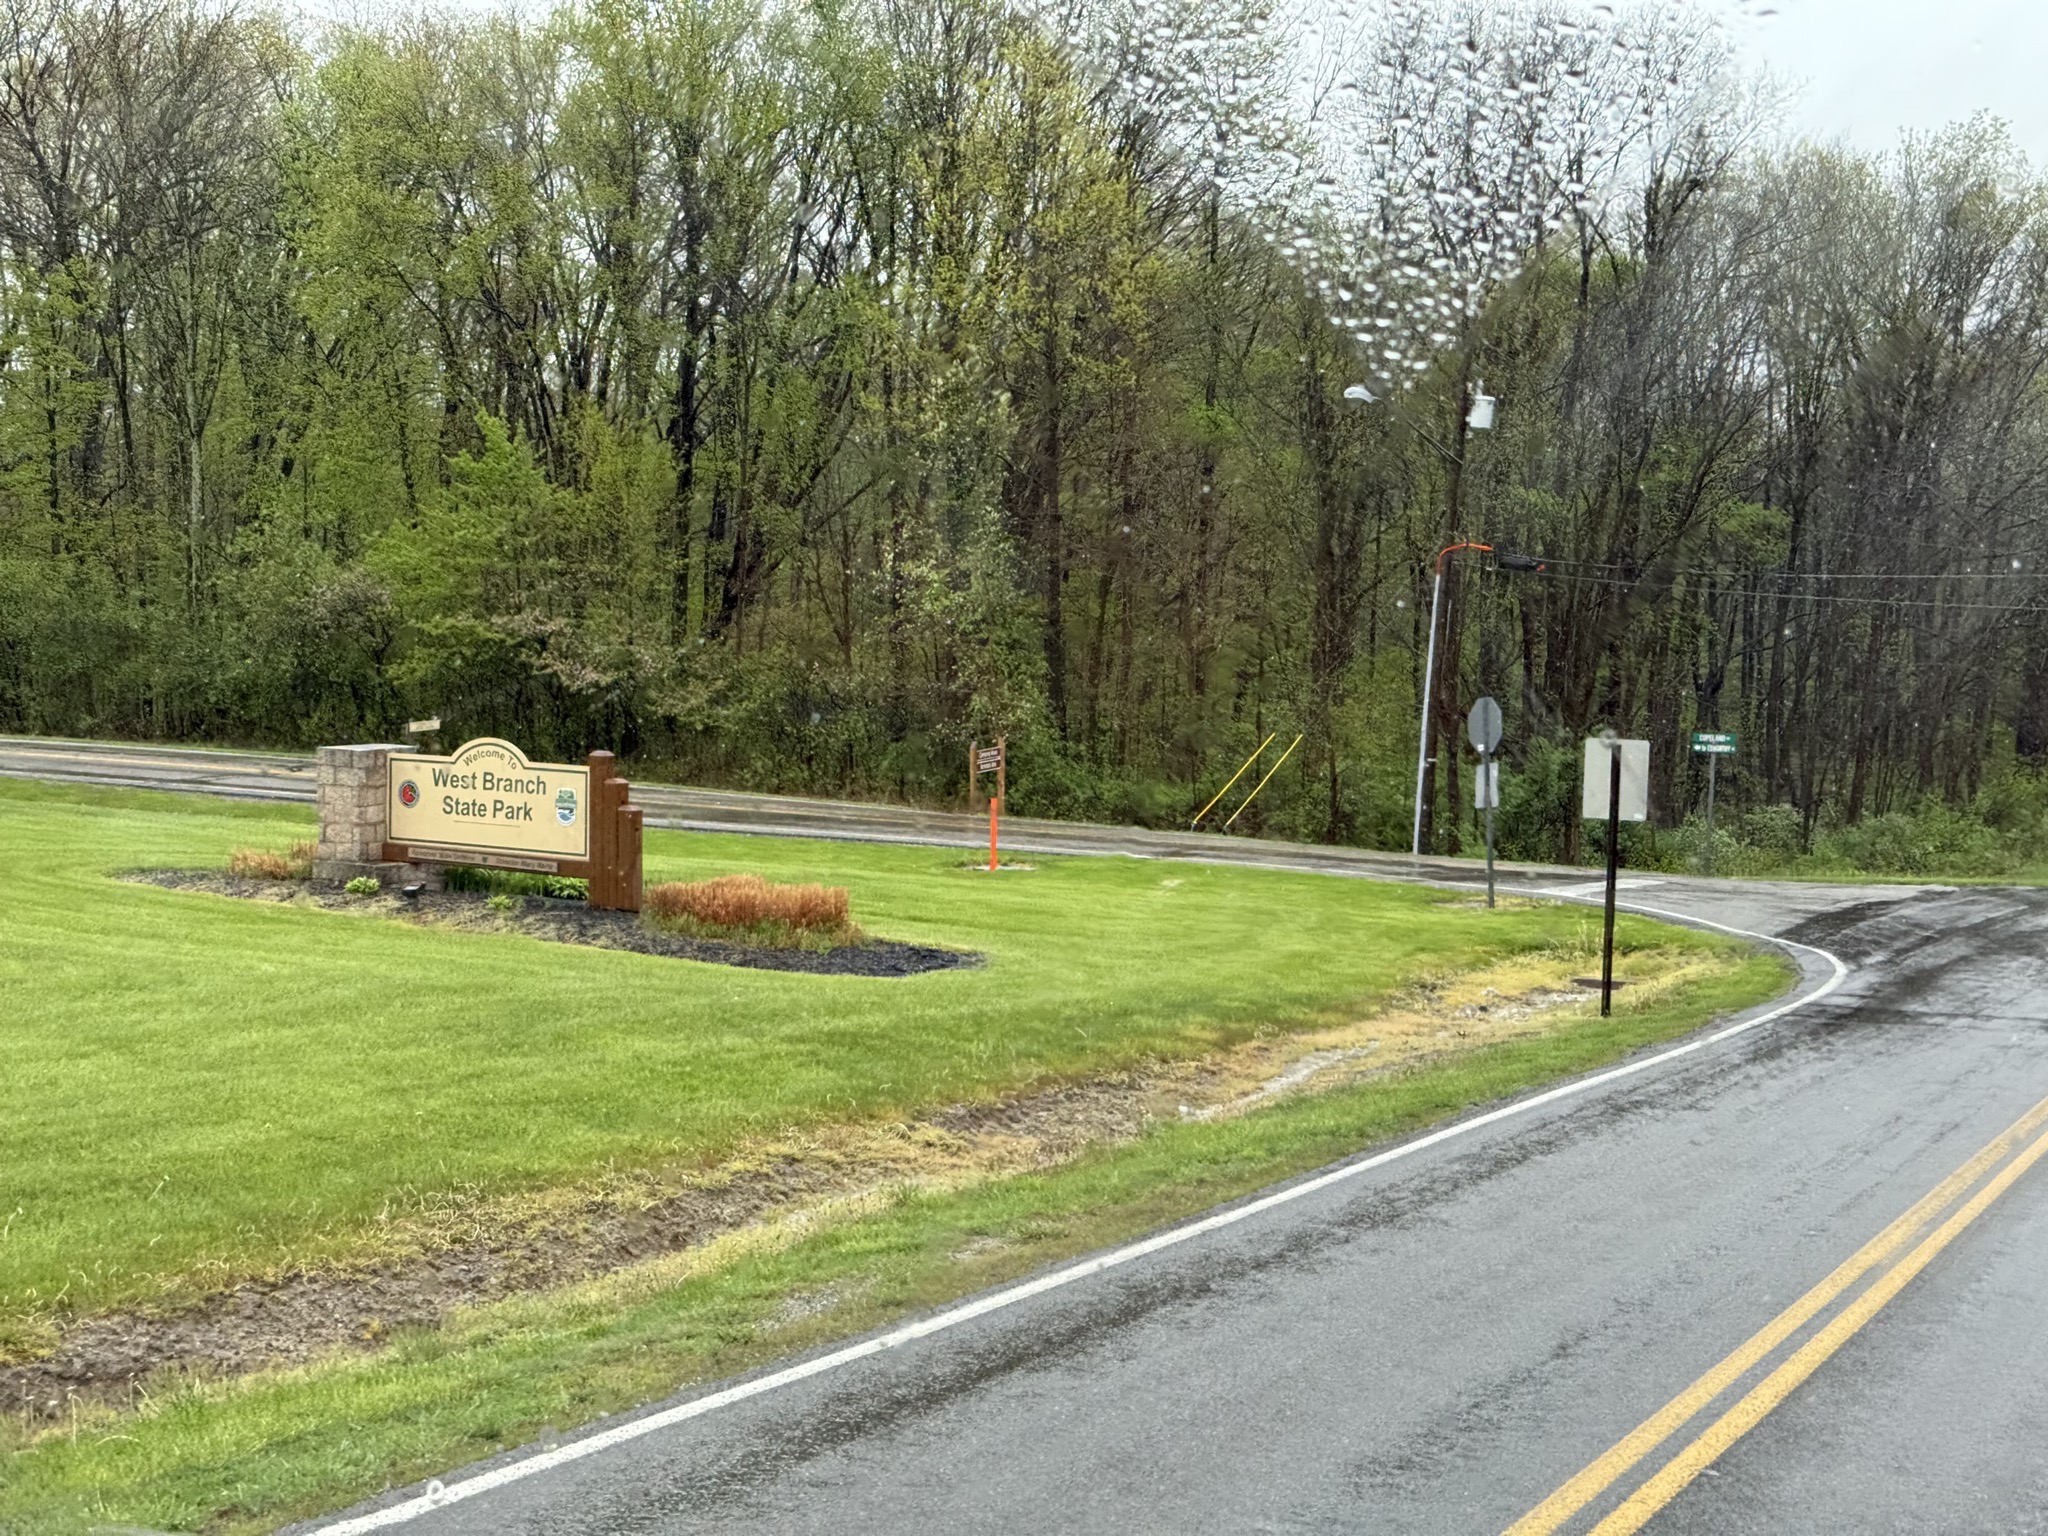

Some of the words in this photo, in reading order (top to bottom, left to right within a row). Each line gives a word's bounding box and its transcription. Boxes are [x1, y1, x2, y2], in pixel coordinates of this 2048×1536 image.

[463, 750, 506, 767] Welcome
[507, 755, 517, 770] To
[432, 767, 477, 789] West
[482, 771, 547, 796] Branch
[442, 795, 487, 818] State
[492, 799, 533, 822] Park
